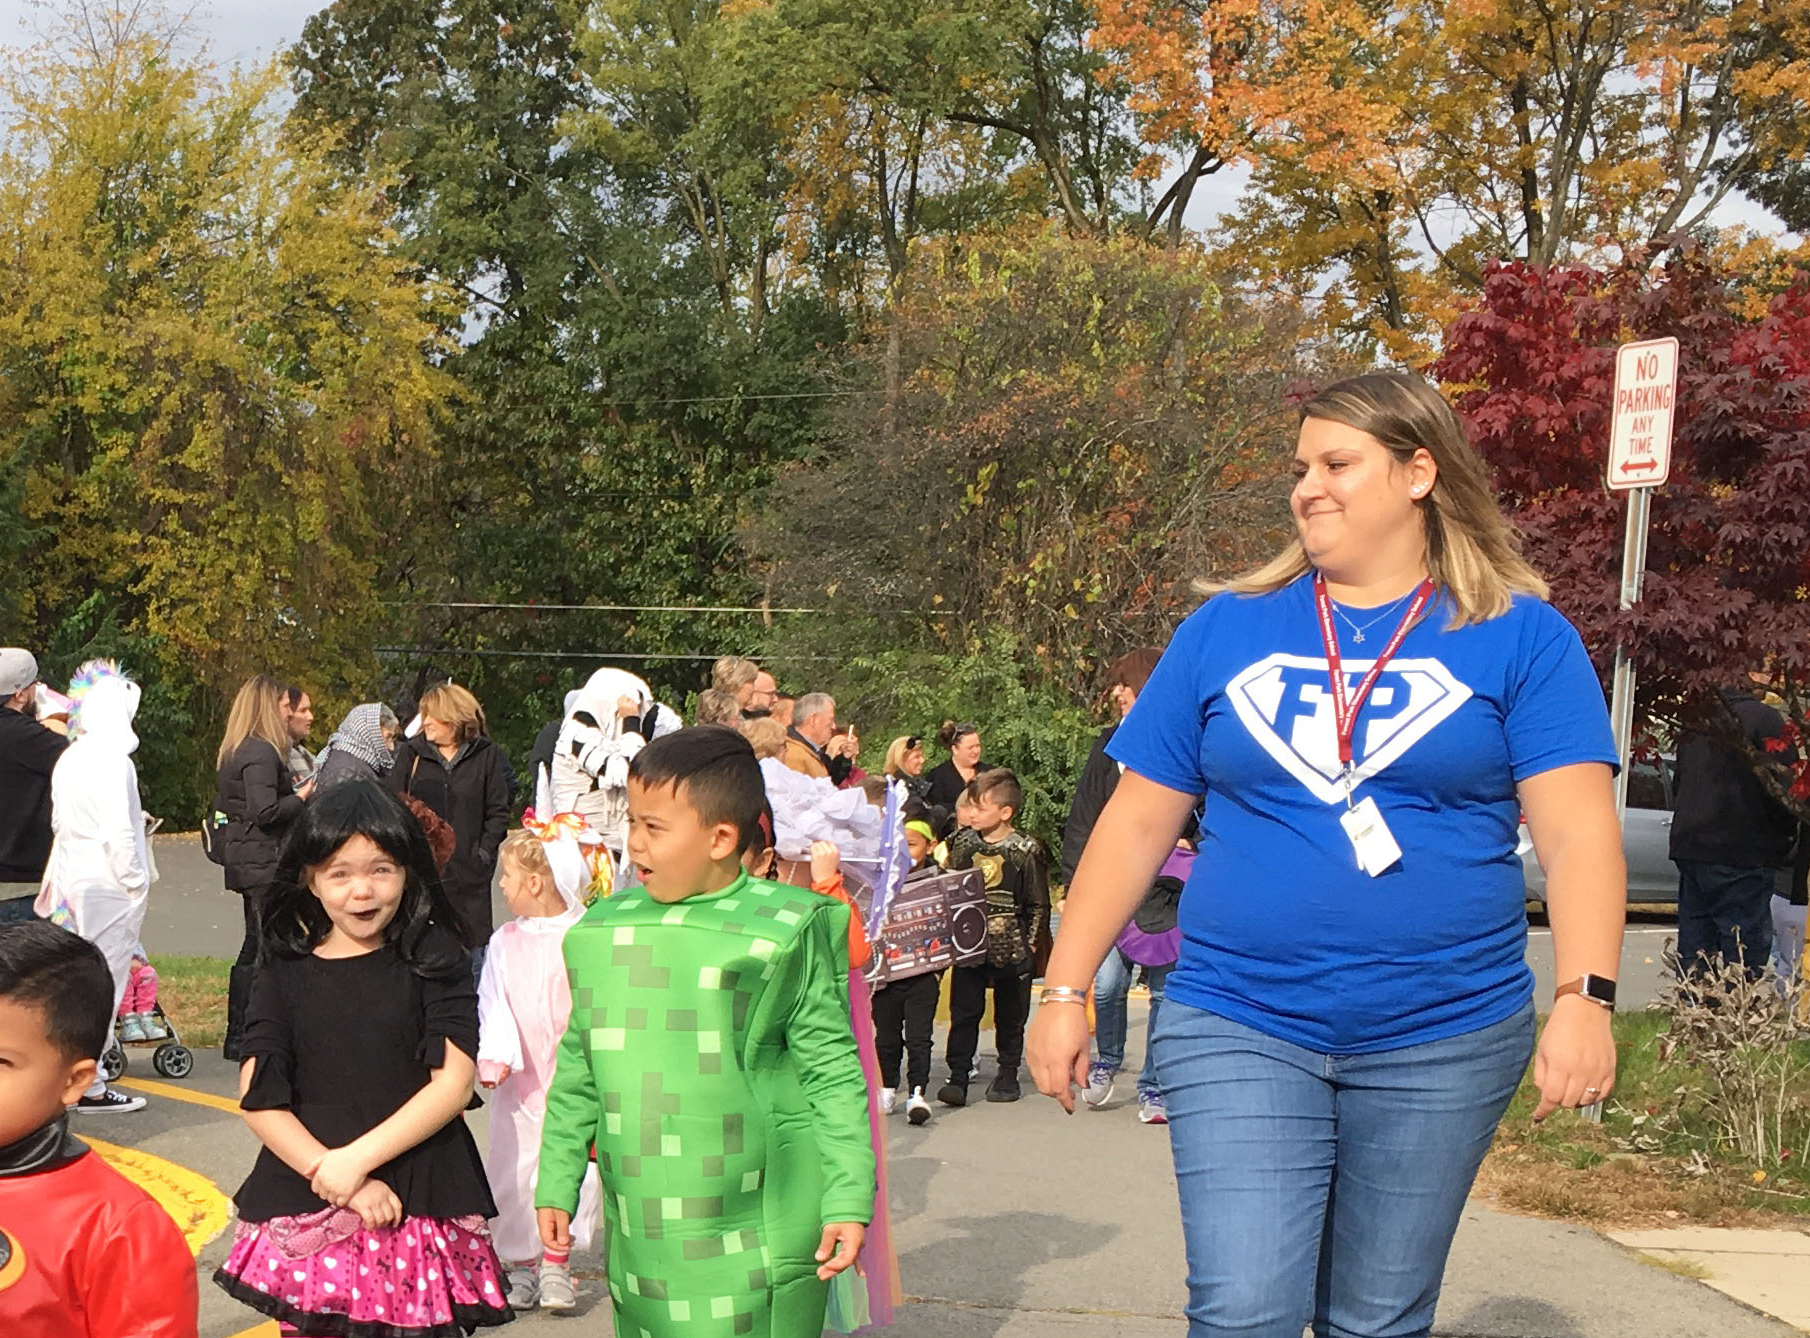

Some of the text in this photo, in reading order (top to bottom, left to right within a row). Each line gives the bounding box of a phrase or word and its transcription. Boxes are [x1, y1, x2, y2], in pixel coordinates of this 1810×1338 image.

[1636, 354, 1658, 381] NO
[1618, 384, 1671, 414] PARKING
[1631, 415, 1654, 435] ANY
[1630, 436, 1654, 455] TIME
[1273, 666, 1412, 767] FP
